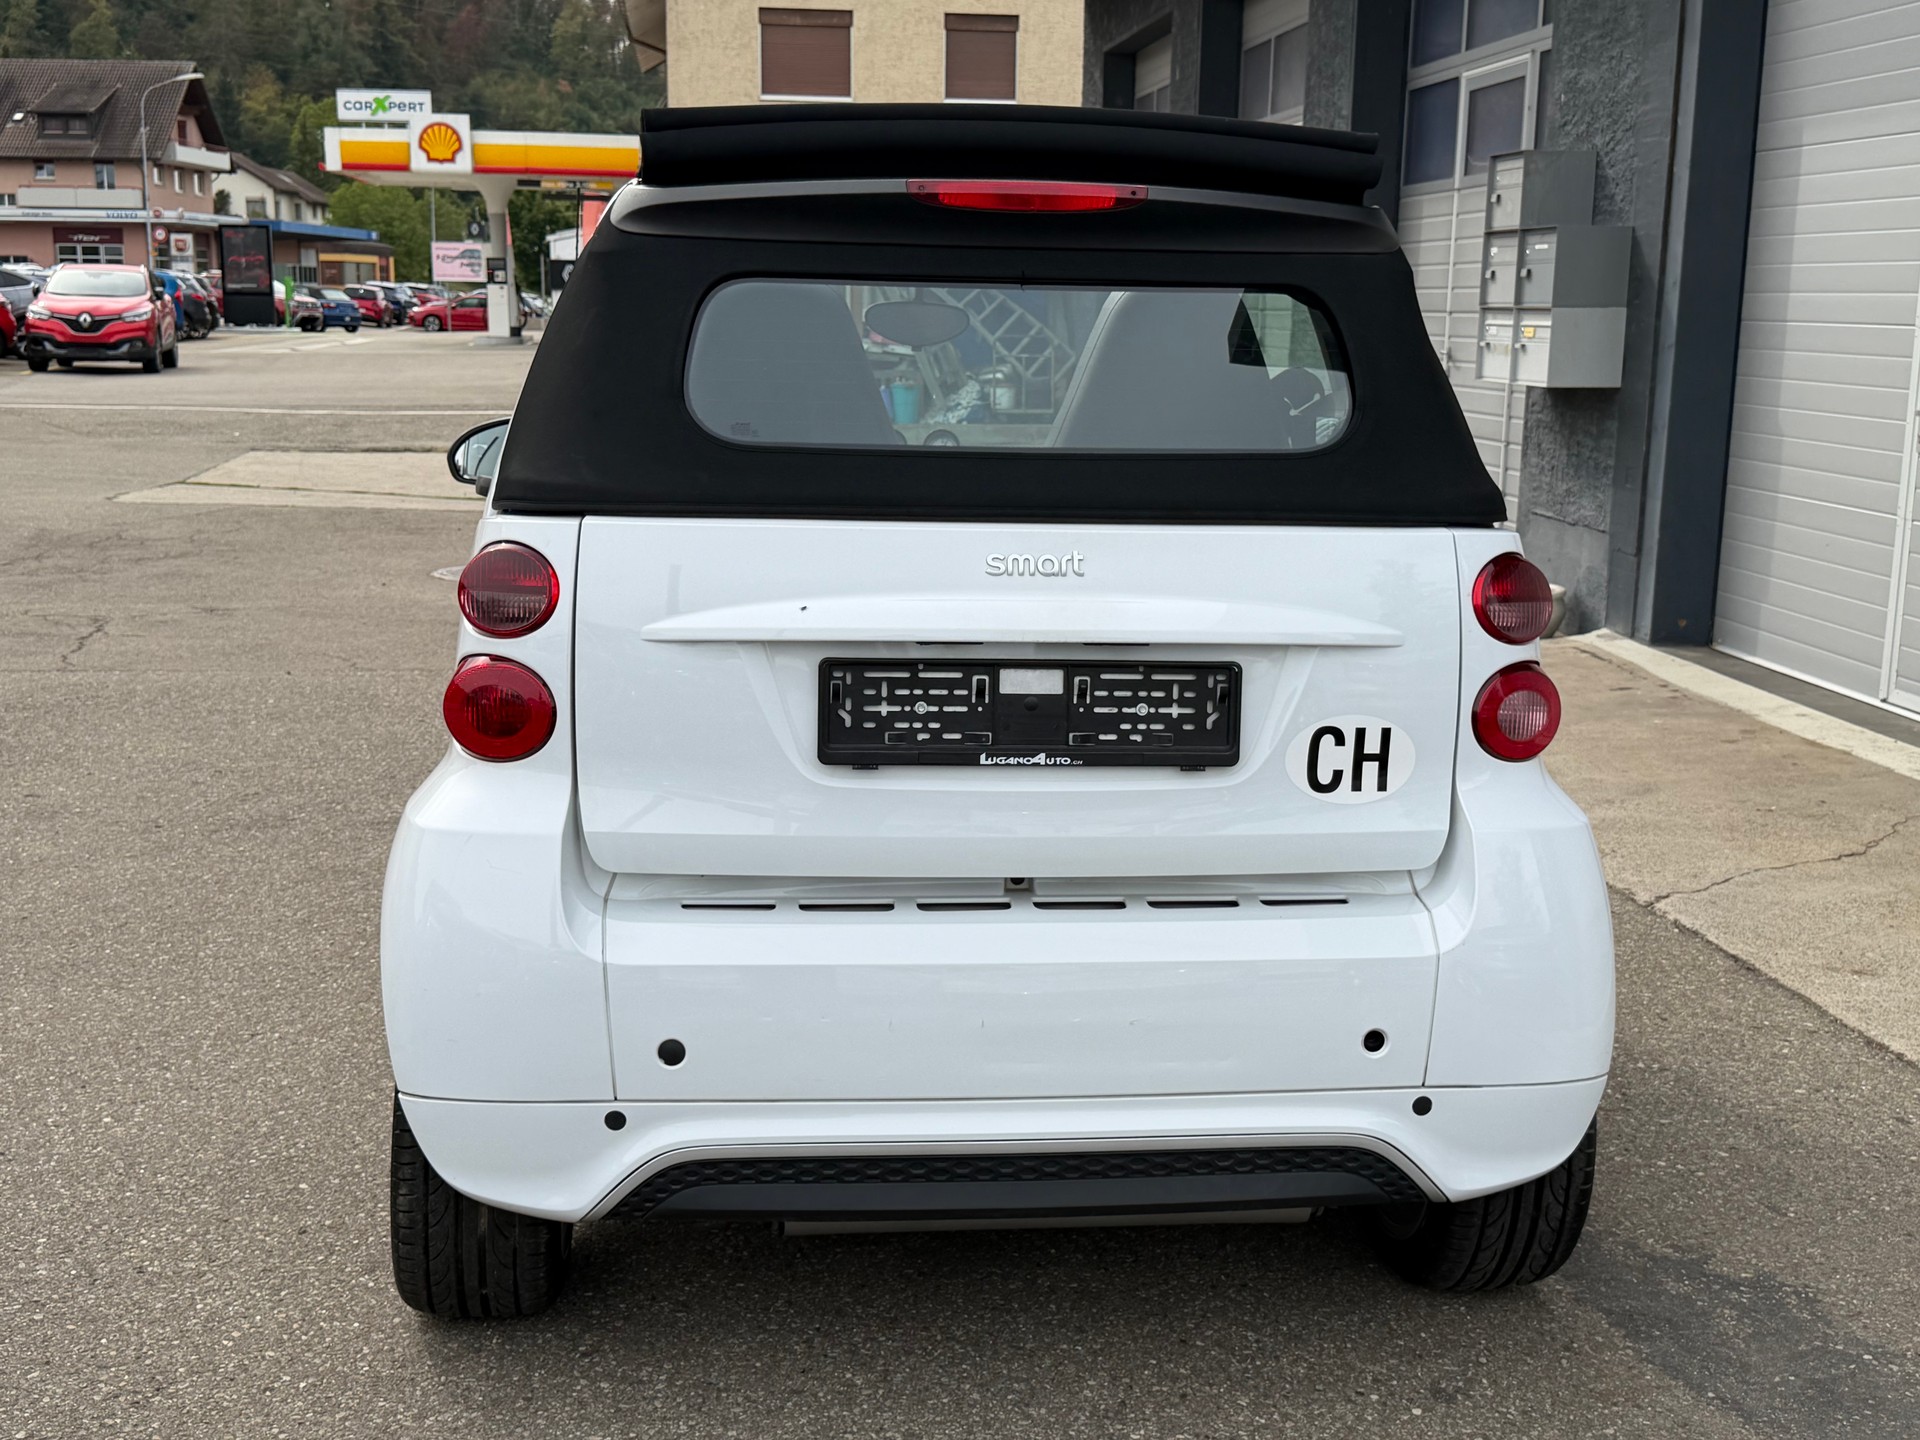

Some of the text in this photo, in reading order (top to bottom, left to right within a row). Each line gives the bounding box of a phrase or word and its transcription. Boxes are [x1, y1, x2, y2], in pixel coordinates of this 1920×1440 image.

[106, 211, 138, 219] VOLVO
[985, 550, 1085, 577] smart
[1306, 725, 1392, 794] CH
